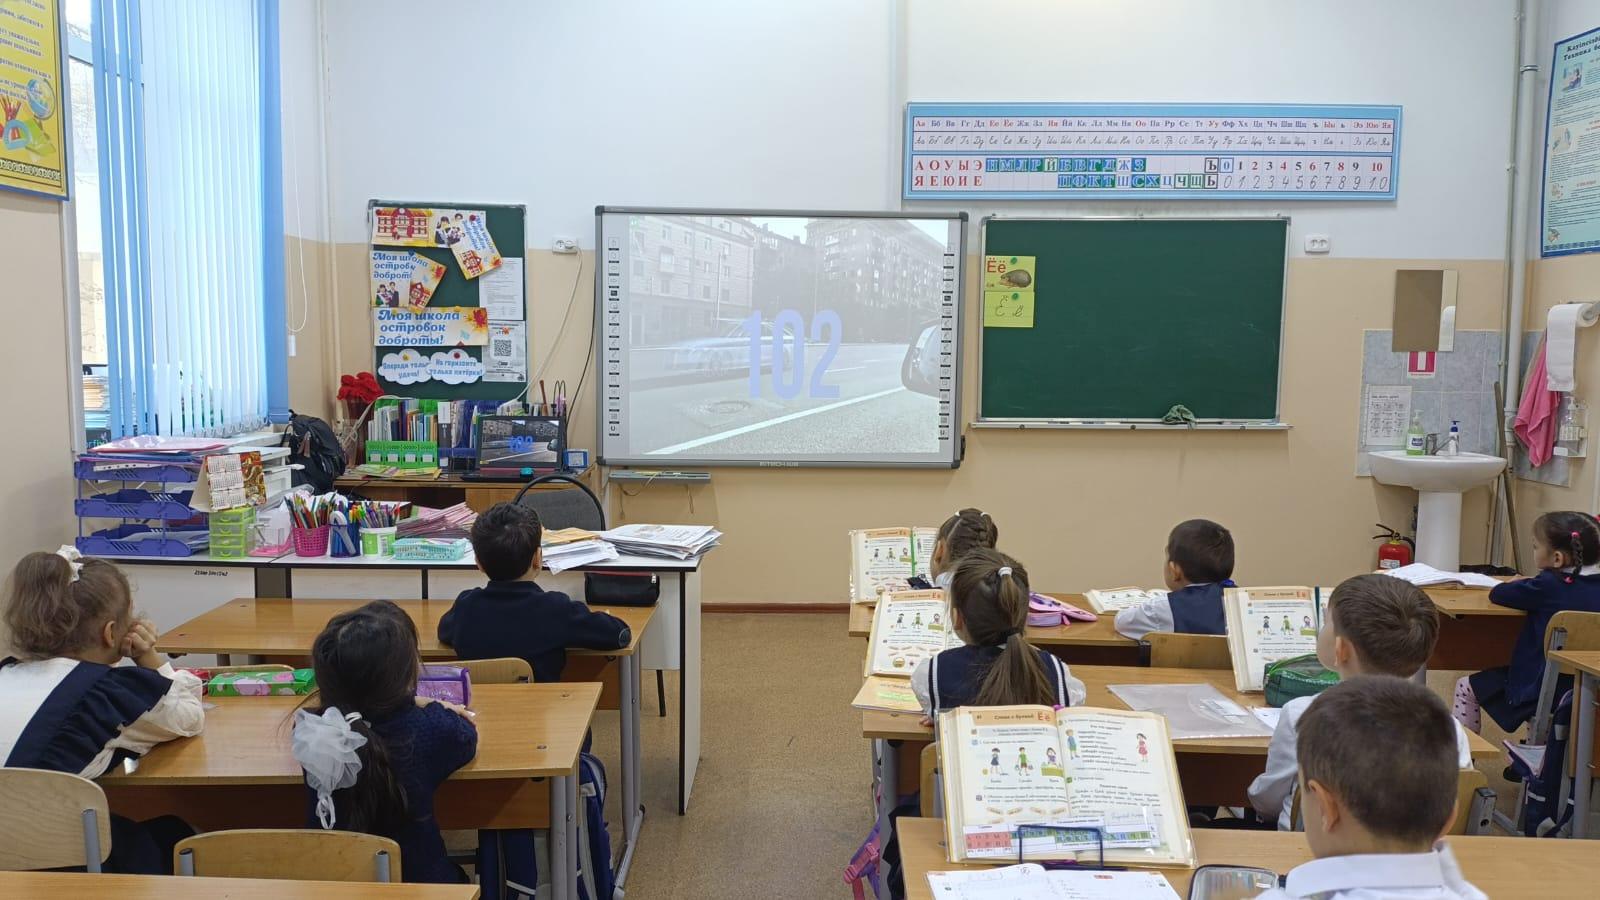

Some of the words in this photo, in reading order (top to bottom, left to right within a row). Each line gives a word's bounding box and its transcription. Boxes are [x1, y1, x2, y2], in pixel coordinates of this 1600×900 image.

[916, 160, 924, 170] А
[930, 160, 940, 170] О
[944, 160, 953, 170] У
[959, 160, 968, 170] Ы
[974, 160, 982, 170] Э
[1224, 162, 1229, 170] 0
[1239, 162, 1242, 170] 1
[1252, 162, 1258, 170] 2
[1266, 162, 1273, 170] 3
[1280, 162, 1287, 170] 4
[1296, 162, 1302, 170] 5
[1310, 162, 1316, 170] 6
[1324, 162, 1330, 170] 7
[1338, 162, 1344, 170] 8
[1353, 162, 1359, 170] 9
[1372, 162, 1383, 171] 10
[915, 176, 923, 186] Я
[944, 176, 955, 186] Ю
[959, 176, 967, 186] И
[1224, 176, 1232, 188] 0
[1239, 176, 1245, 188] 1
[1254, 176, 1260, 188] 2
[1268, 176, 1274, 188] 3
[1283, 176, 1289, 188] 4
[1296, 176, 1303, 188] 5
[1310, 176, 1317, 188] 6
[1325, 176, 1332, 188] 7
[1338, 176, 1346, 188] 8
[1353, 176, 1360, 188] 9
[373, 252, 397, 261] Моя
[987, 257, 1007, 274] Ёё
[378, 310, 411, 320] Моя
[415, 312, 460, 320] школа
[380, 322, 446, 334] островок
[378, 335, 444, 346] доброты!
[748, 309, 843, 400] 102
[509, 435, 533, 453] 102
